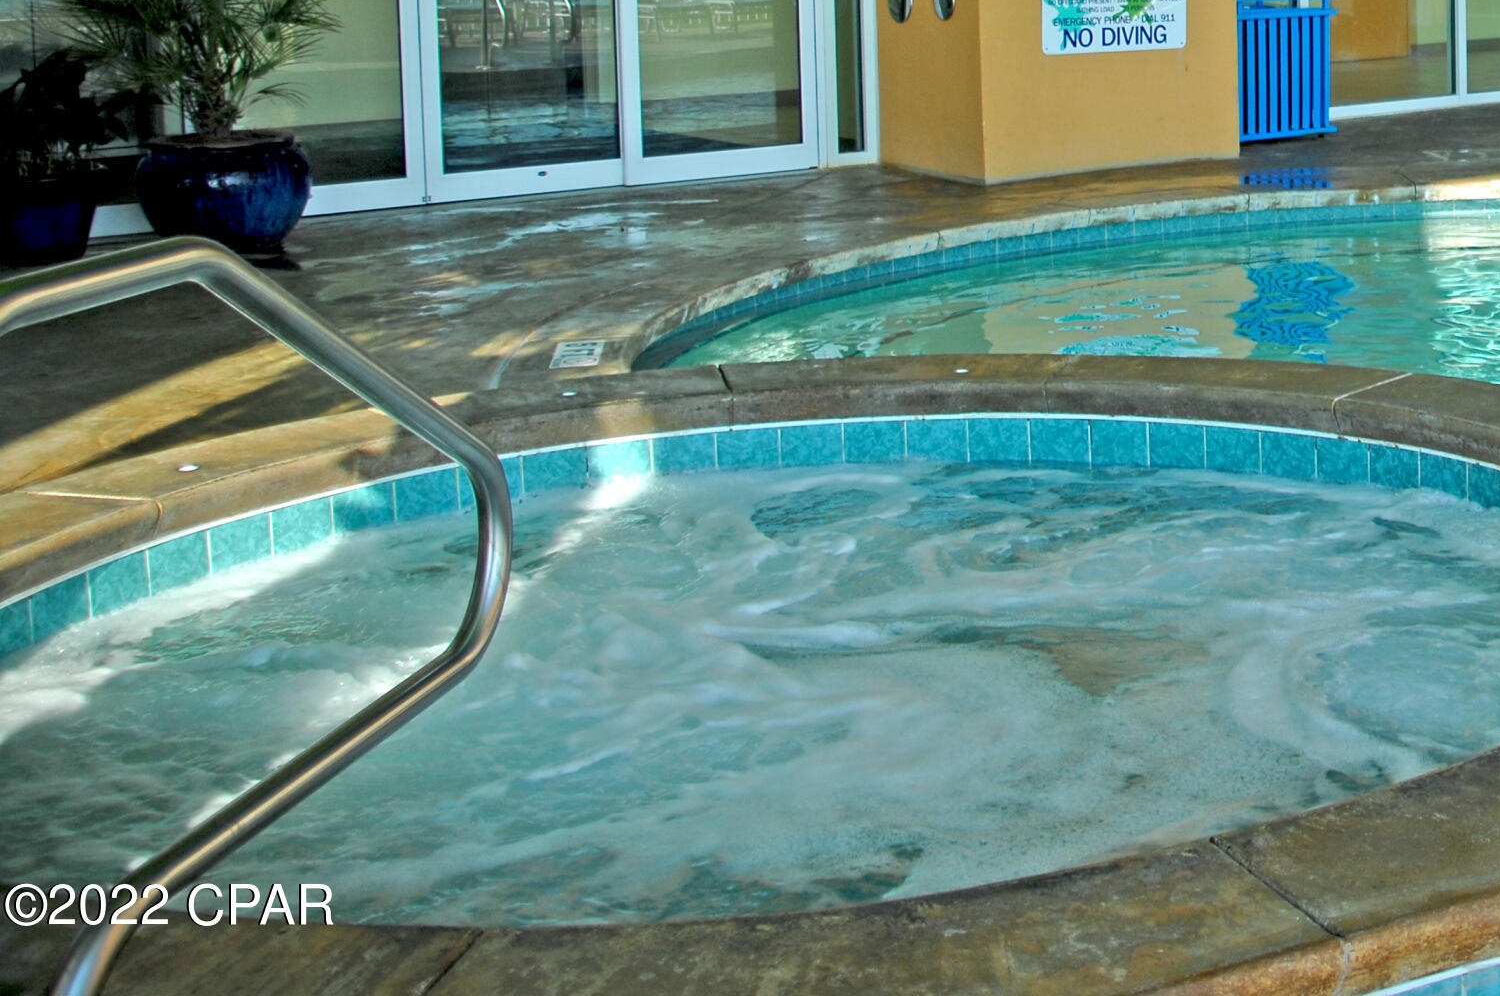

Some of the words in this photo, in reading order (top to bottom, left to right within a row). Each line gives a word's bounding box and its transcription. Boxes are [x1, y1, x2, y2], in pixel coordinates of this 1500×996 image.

[1054, 16, 1102, 26] EMERGENCY
[1104, 14, 1130, 24] PHONE
[1160, 13, 1175, 22] 911
[1063, 28, 1094, 49] NO
[1102, 24, 1168, 46] DIVING
